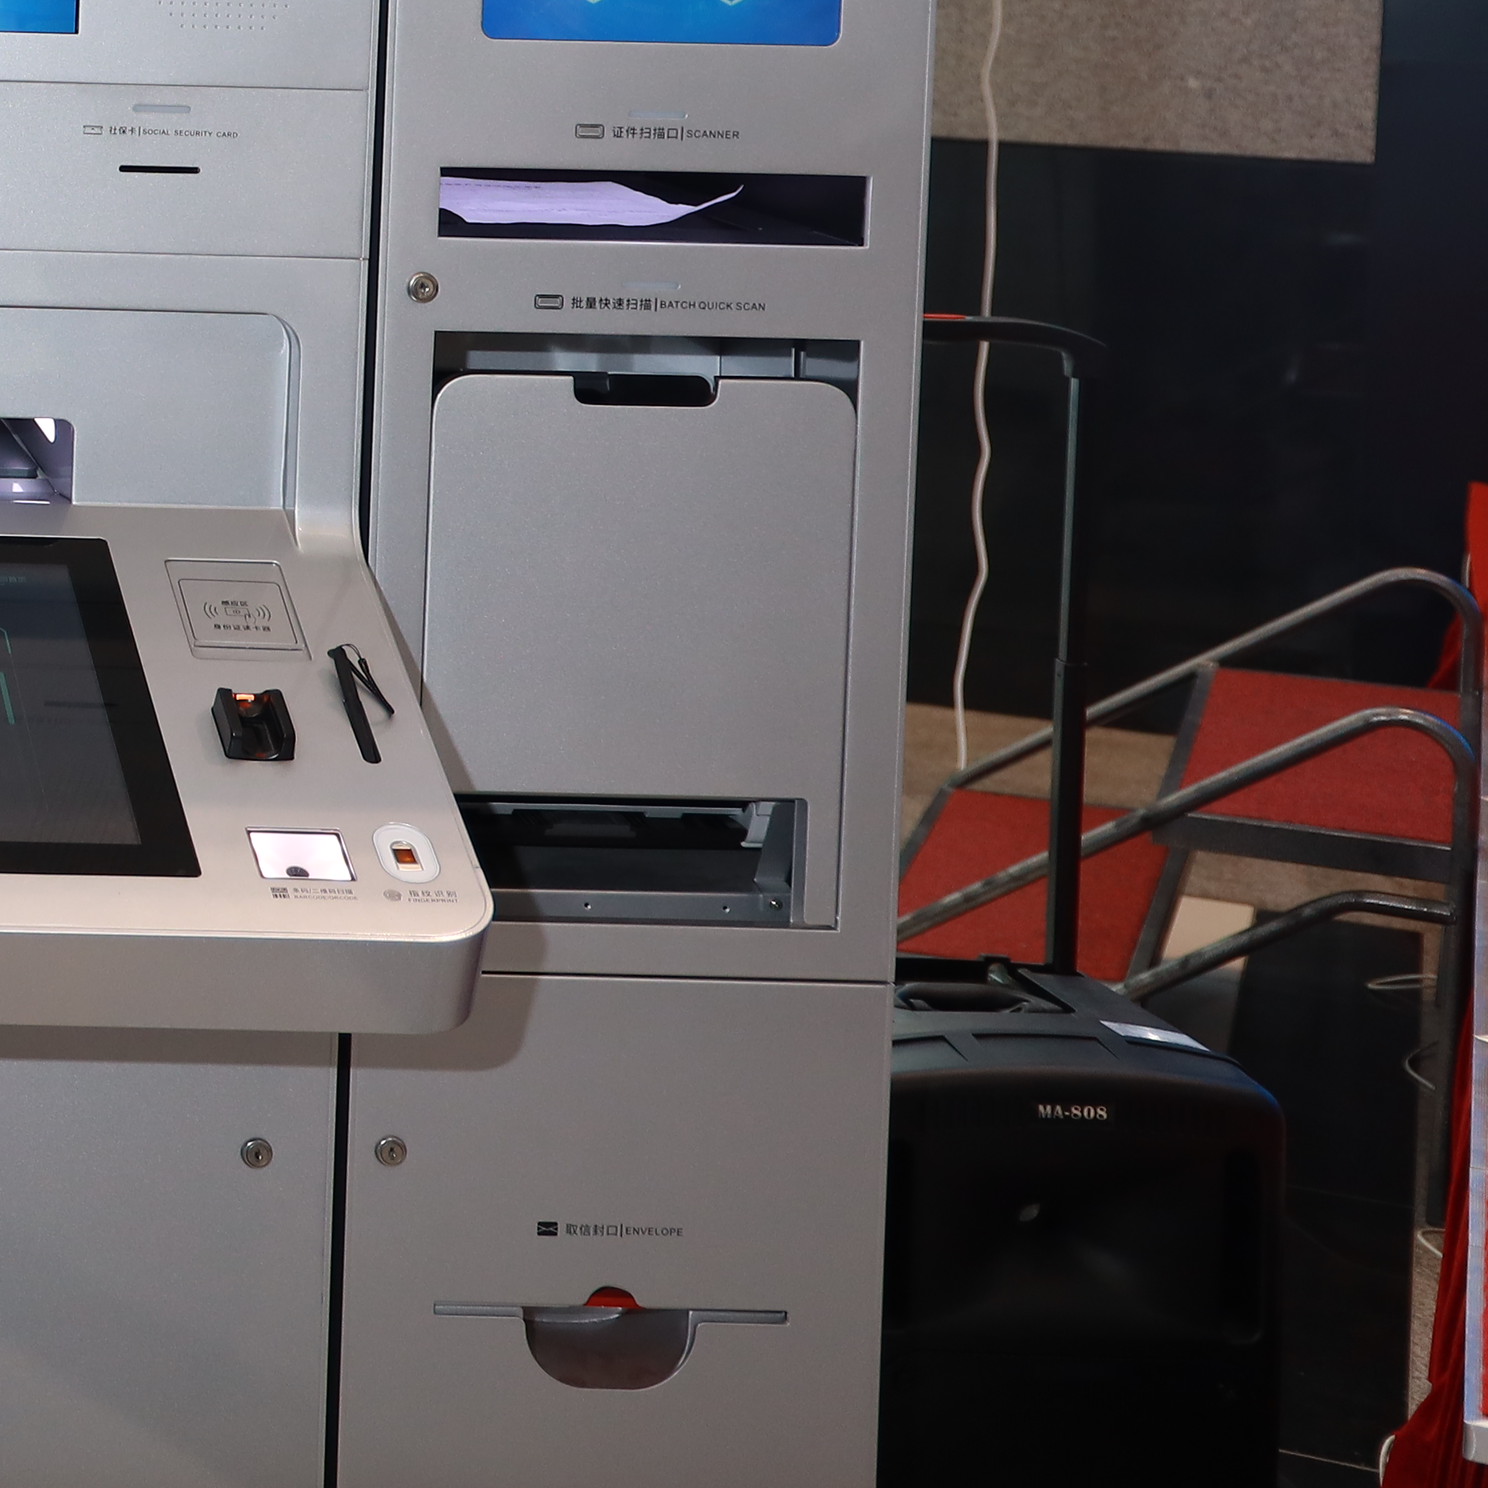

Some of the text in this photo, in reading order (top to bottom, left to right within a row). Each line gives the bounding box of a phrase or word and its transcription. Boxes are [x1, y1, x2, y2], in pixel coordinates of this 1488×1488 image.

[109, 125, 136, 135] 社保卡
[143, 128, 170, 136] SOCIAL
[174, 130, 213, 138] SECURITY
[612, 126, 740, 140] 证件扫描口 SCANNER
[571, 296, 766, 312] 批量快速扫描 BATCH QUICK SCAN
[1038, 1104, 1107, 1120] MA-808
[566, 1223, 683, 1236] 取信封口 ENVELOPE
